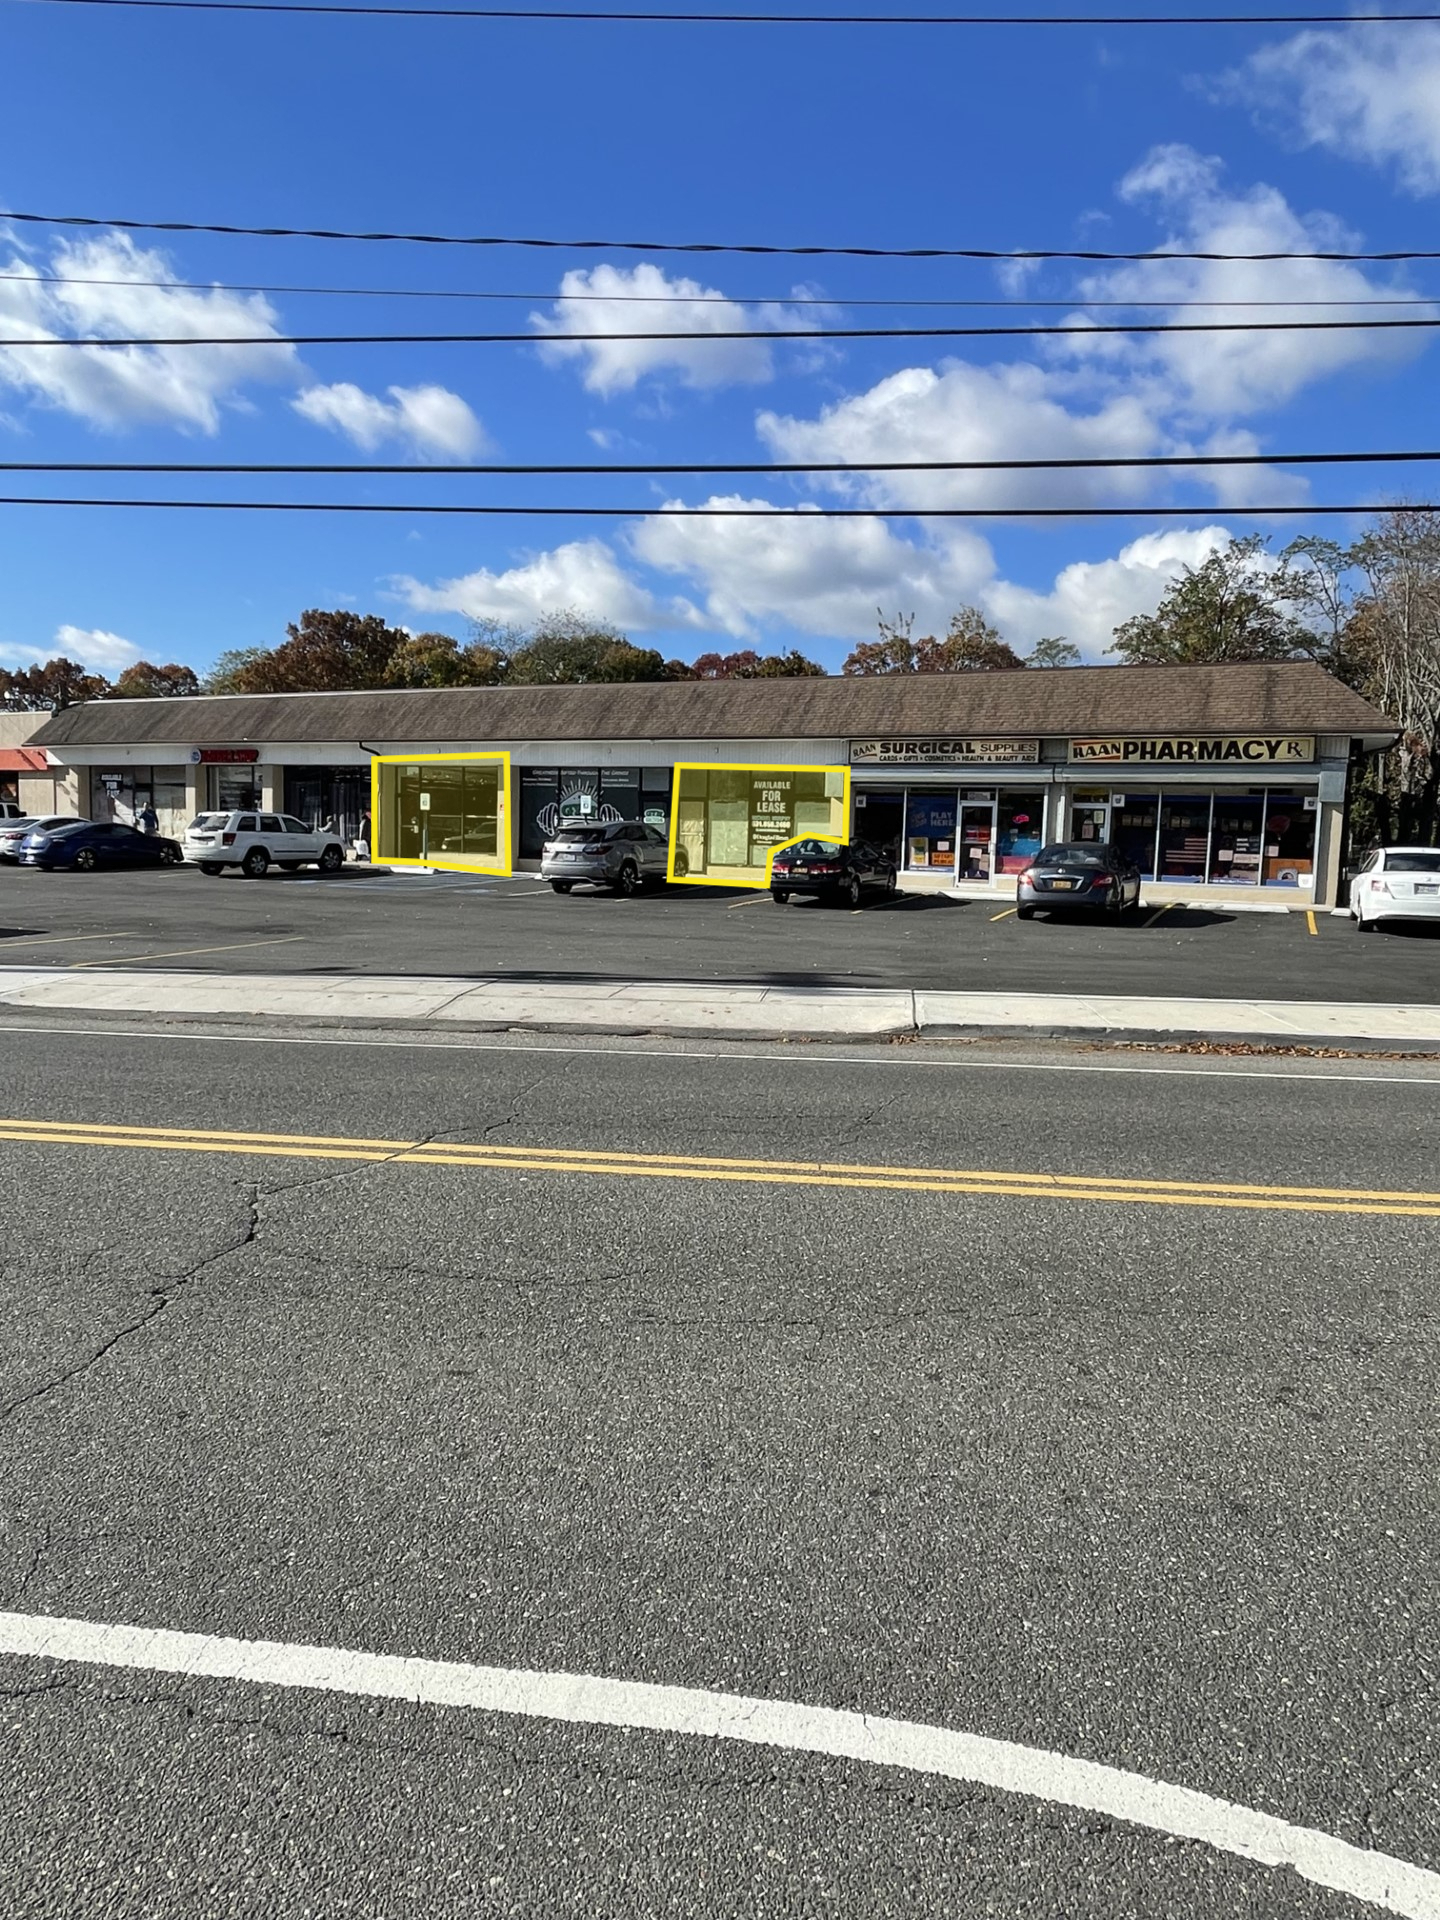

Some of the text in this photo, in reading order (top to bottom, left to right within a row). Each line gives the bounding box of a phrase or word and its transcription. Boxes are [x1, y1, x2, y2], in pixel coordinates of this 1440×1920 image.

[853, 742, 1036, 757] RAAN SURGICAL SUPPLIES
[1073, 743, 1120, 758] RAAN
[1122, 741, 1284, 760] PHARMACY
[753, 781, 791, 789] AVAILABLE
[762, 790, 781, 801] FOR
[757, 802, 786, 813] LEASE
[930, 811, 952, 819] PLAY
